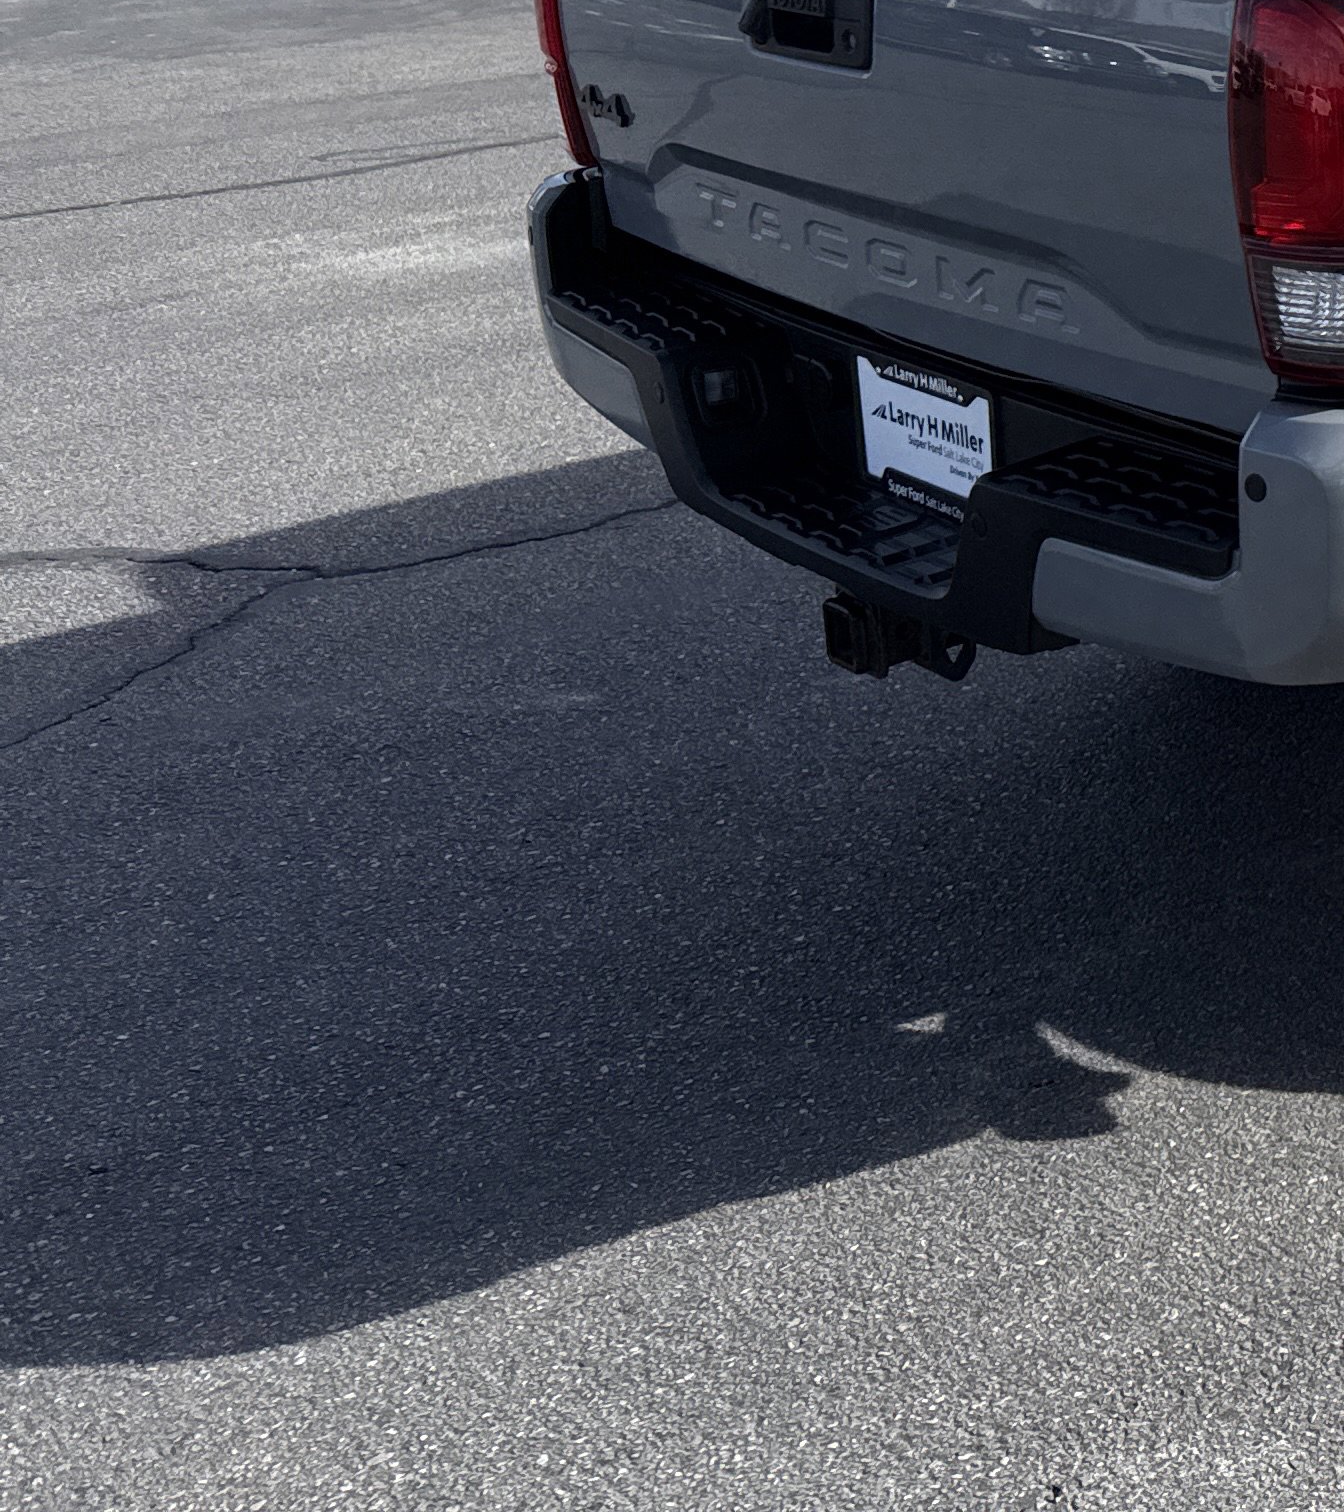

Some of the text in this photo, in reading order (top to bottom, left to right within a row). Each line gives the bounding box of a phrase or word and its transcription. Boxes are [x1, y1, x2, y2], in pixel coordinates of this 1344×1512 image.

[696, 182, 1080, 335] TACOMA
[894, 364, 959, 398] Larry H Miller
[888, 401, 984, 454] Larry H Miller
